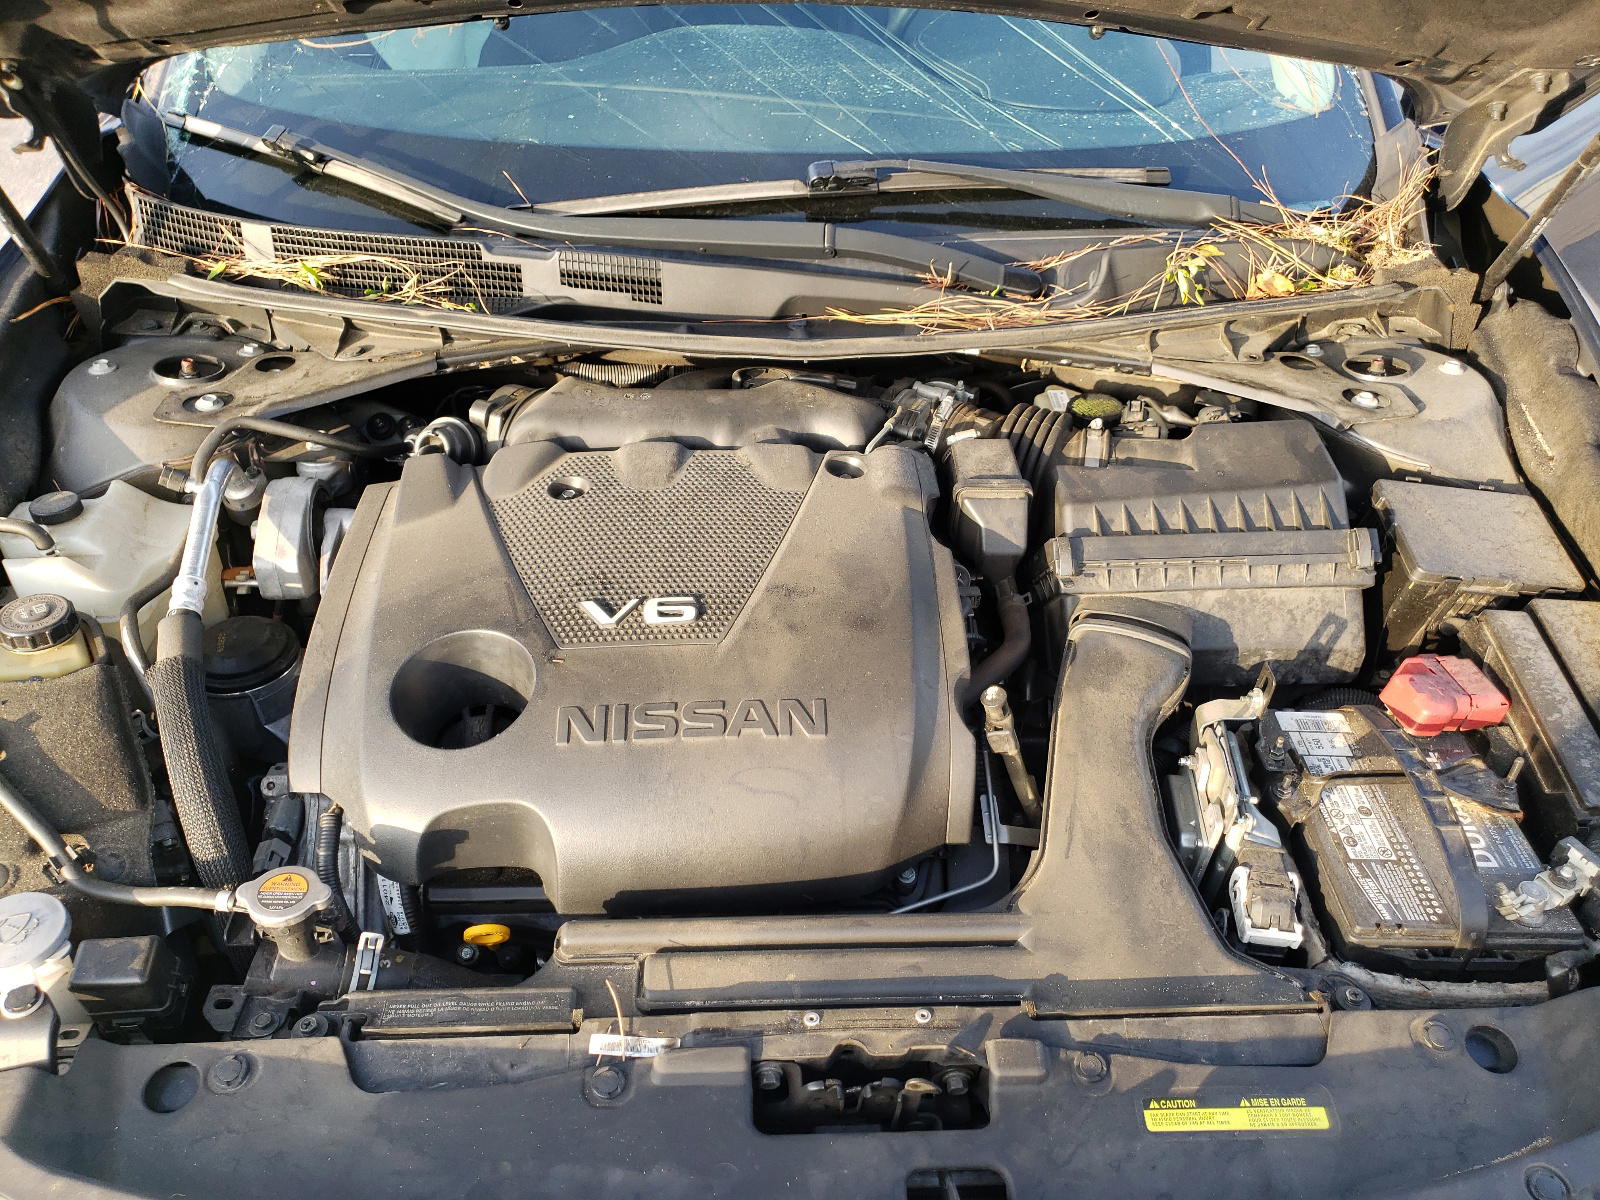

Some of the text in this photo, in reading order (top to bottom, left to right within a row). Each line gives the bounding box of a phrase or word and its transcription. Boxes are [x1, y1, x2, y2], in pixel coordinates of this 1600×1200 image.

[579, 596, 699, 626] V6
[556, 698, 829, 746] NISSAN
[1365, 877, 1388, 905] BATTERY
[1160, 1099, 1196, 1108] CAUTION
[1251, 1097, 1306, 1107] MISE EN GARDE
